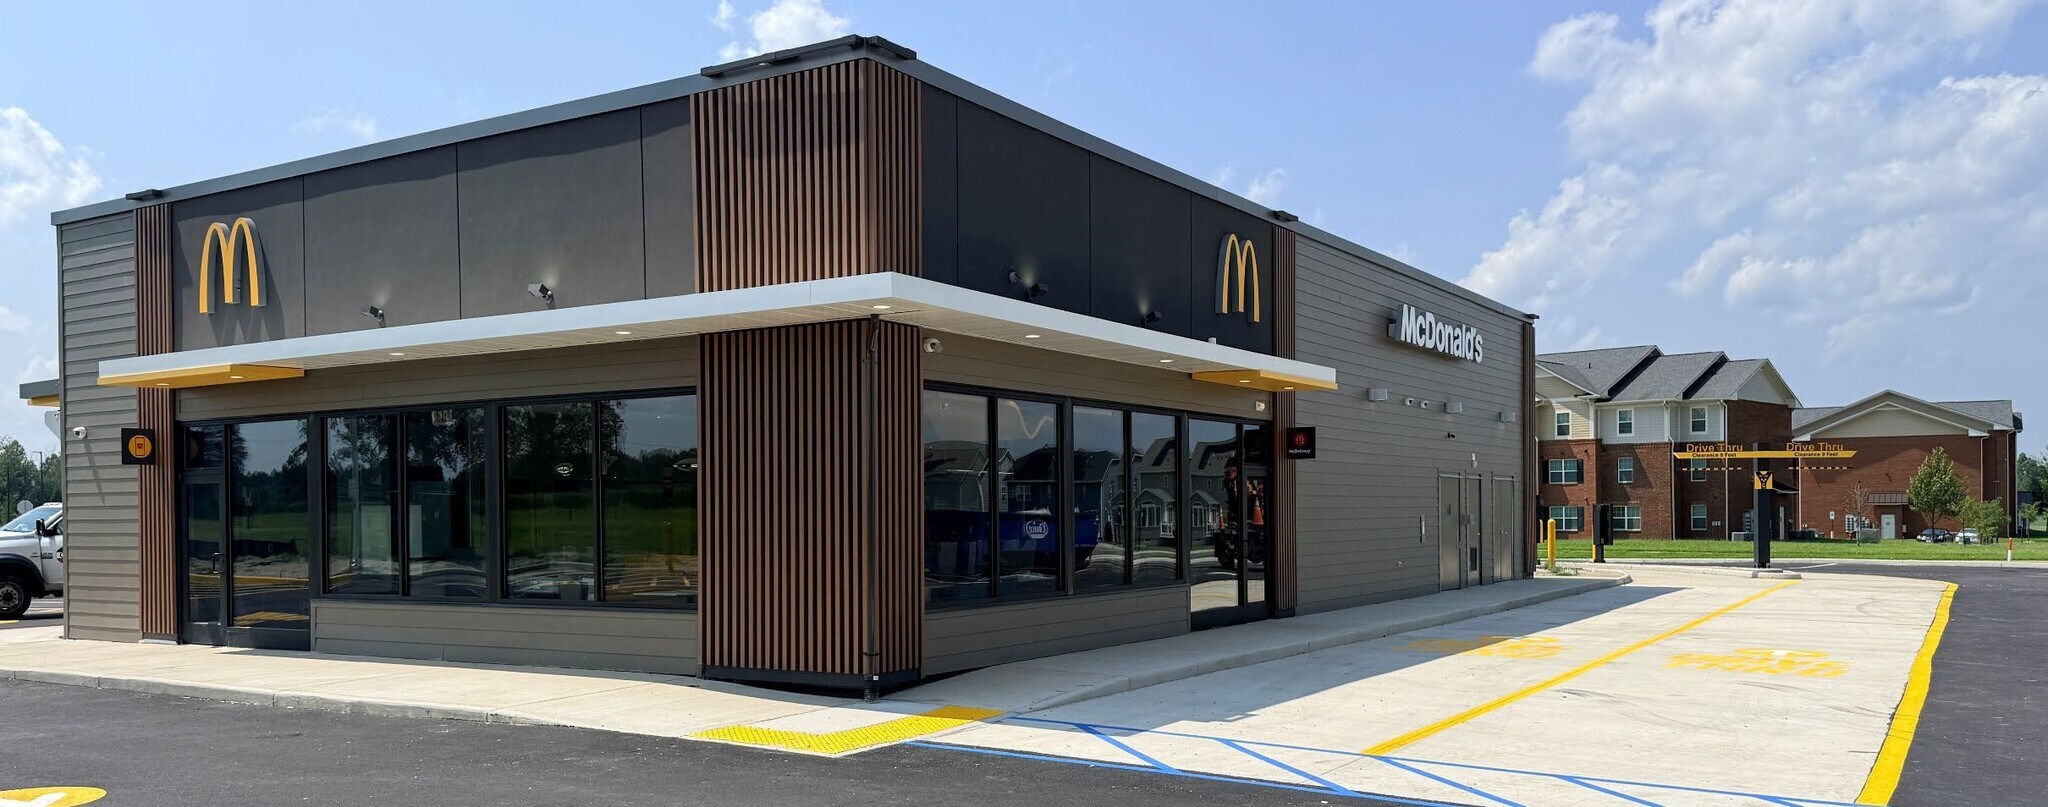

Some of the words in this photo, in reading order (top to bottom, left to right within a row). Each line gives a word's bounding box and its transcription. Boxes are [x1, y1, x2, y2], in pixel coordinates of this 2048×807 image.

[1400, 303, 1484, 364] McDonald's
[1686, 443, 1715, 452] Drive
[1718, 443, 1743, 452] Thru
[1786, 442, 1815, 451] Drive
[1818, 442, 1844, 451] Thru
